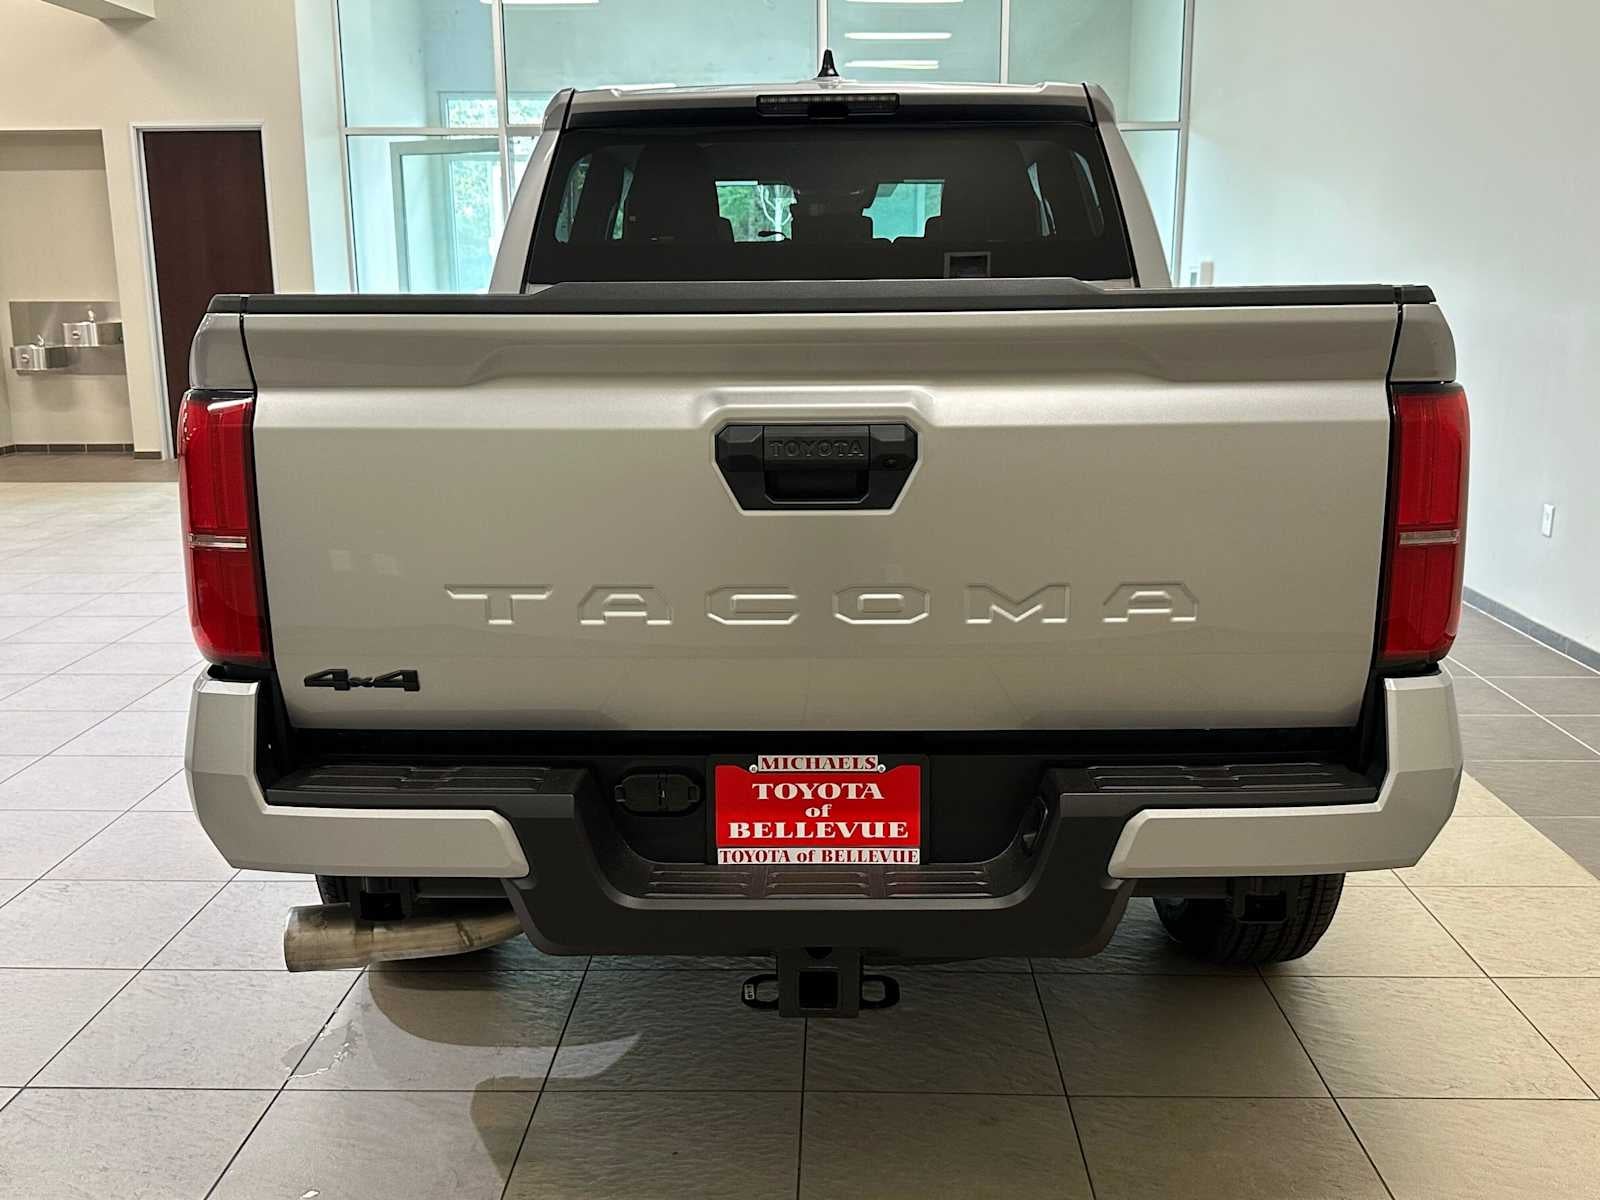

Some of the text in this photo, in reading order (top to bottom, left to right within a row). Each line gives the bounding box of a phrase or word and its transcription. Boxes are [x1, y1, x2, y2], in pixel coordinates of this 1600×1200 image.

[768, 440, 865, 457] TOYOTA
[445, 583, 1198, 625] TACOMA
[760, 757, 877, 770] MICHAELS
[752, 783, 885, 800] TOYOTA
[805, 804, 832, 818] of
[728, 822, 909, 839] BELLEVUE
[719, 849, 919, 863] TOYOTA of BELLEVUE
